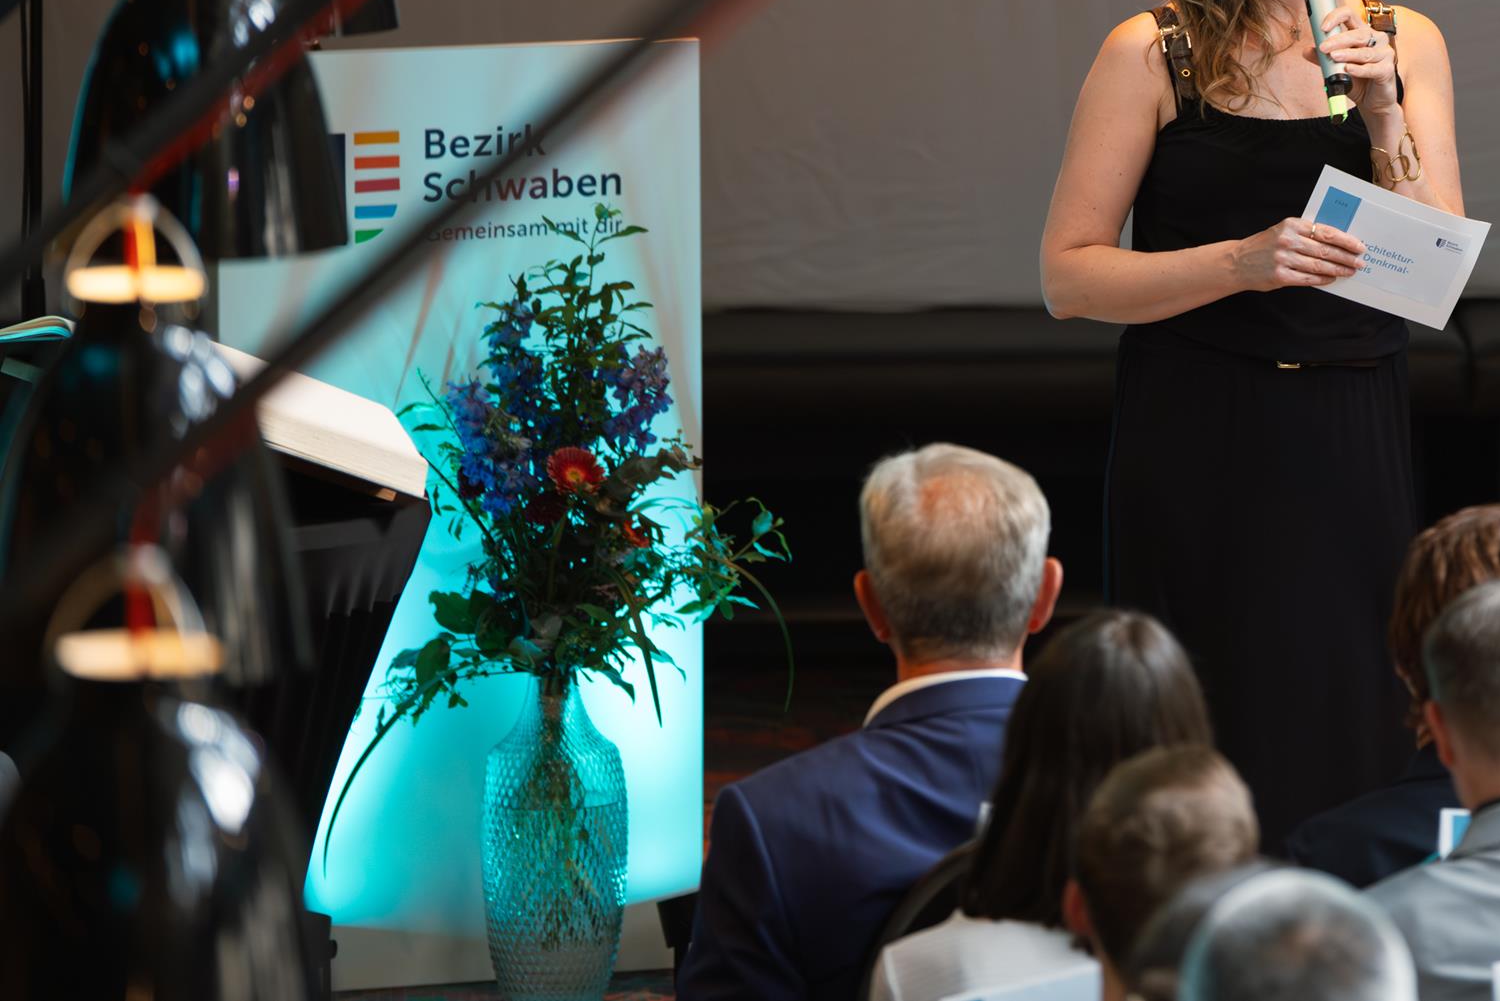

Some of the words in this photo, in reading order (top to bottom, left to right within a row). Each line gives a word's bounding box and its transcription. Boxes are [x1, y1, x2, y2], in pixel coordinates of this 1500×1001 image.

[424, 123, 546, 160] Bezirk
[423, 168, 622, 203] Schwaben
[426, 218, 549, 242] Gemeinsam
